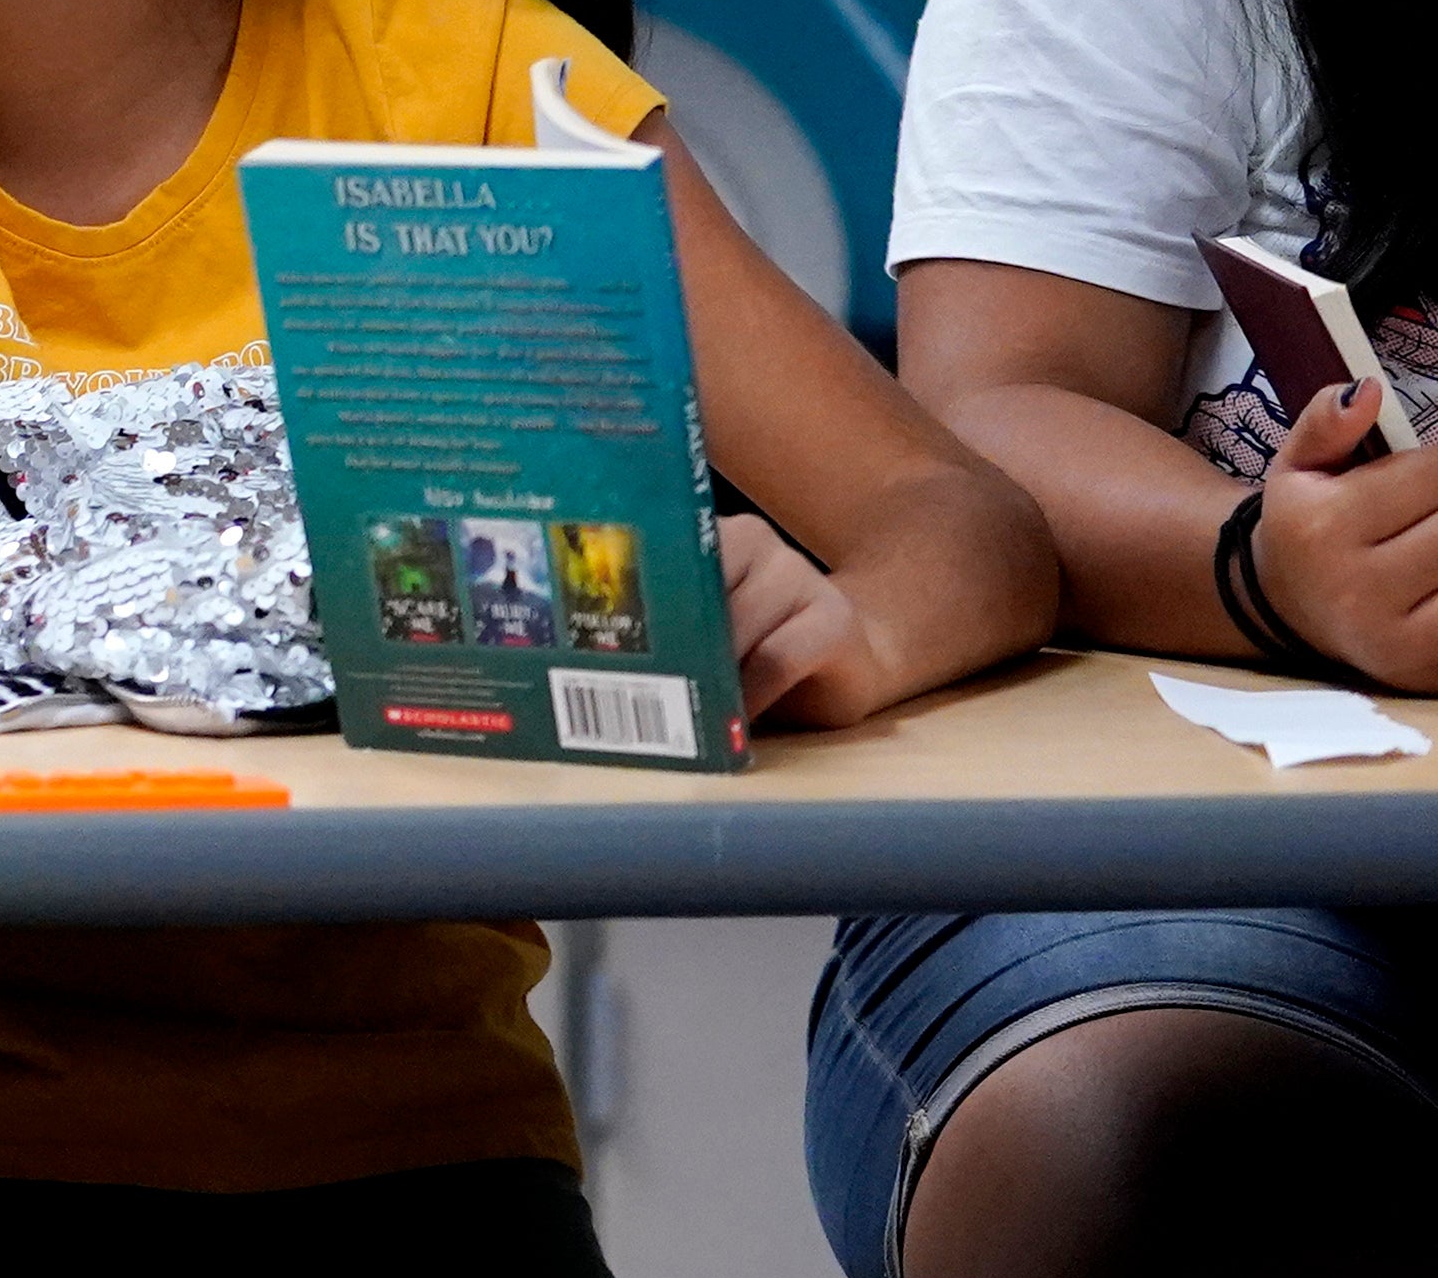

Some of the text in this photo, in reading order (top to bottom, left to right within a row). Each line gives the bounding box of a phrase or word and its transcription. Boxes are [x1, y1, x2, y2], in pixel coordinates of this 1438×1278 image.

[335, 175, 497, 210] ISABELLA
[345, 220, 554, 257] IS THAT YOU?
